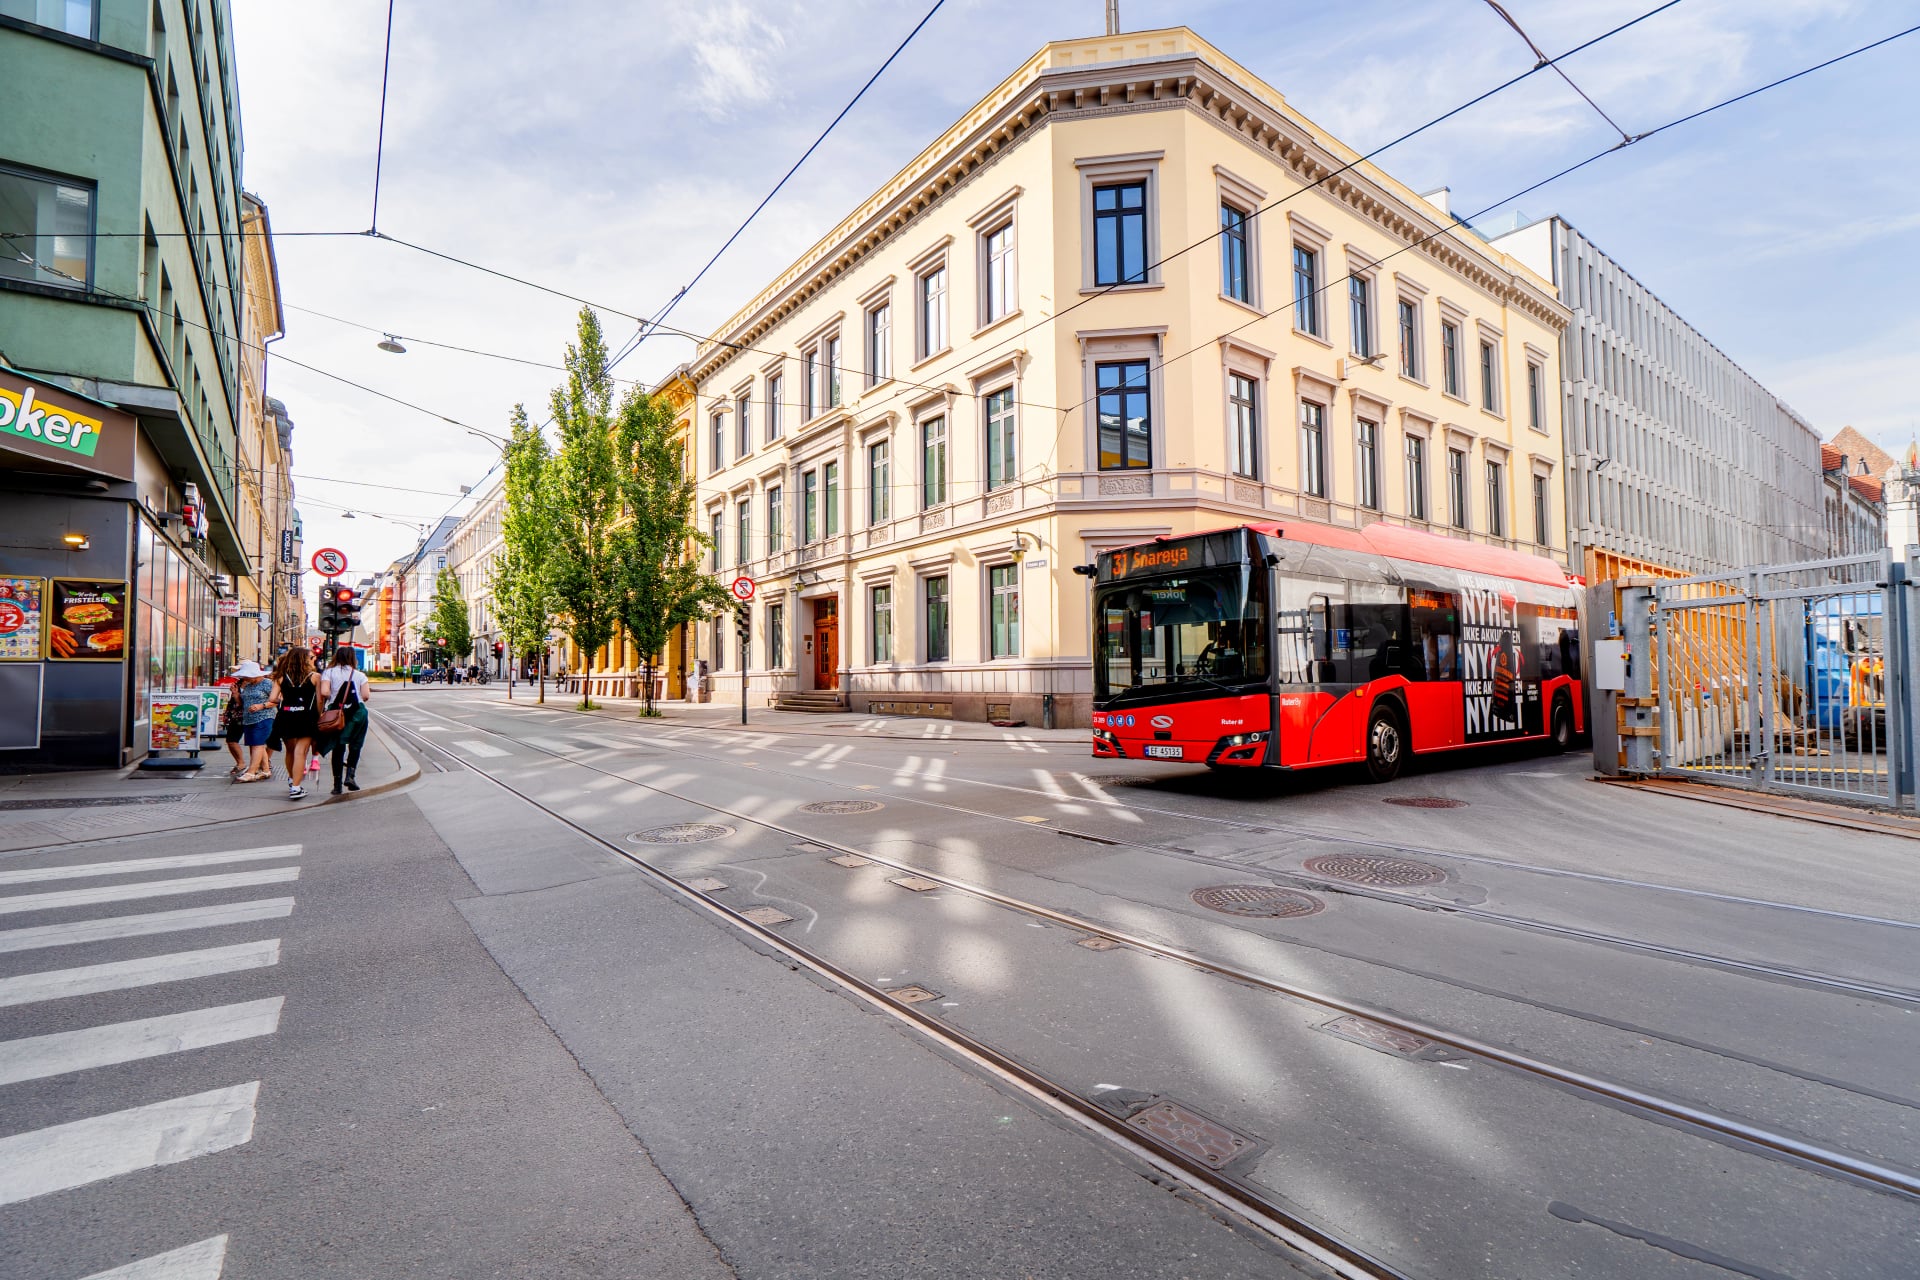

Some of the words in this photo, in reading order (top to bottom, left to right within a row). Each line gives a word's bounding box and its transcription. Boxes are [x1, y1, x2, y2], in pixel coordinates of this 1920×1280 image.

[1111, 552, 1128, 577] 31
[1133, 546, 1189, 569] Snarøya
[1464, 627, 1481, 641] IKKE
[1464, 643, 1522, 680] NYT
[1465, 681, 1482, 695] IKKE
[1466, 695, 1524, 735] NYT
[1150, 747, 1158, 755] EF
